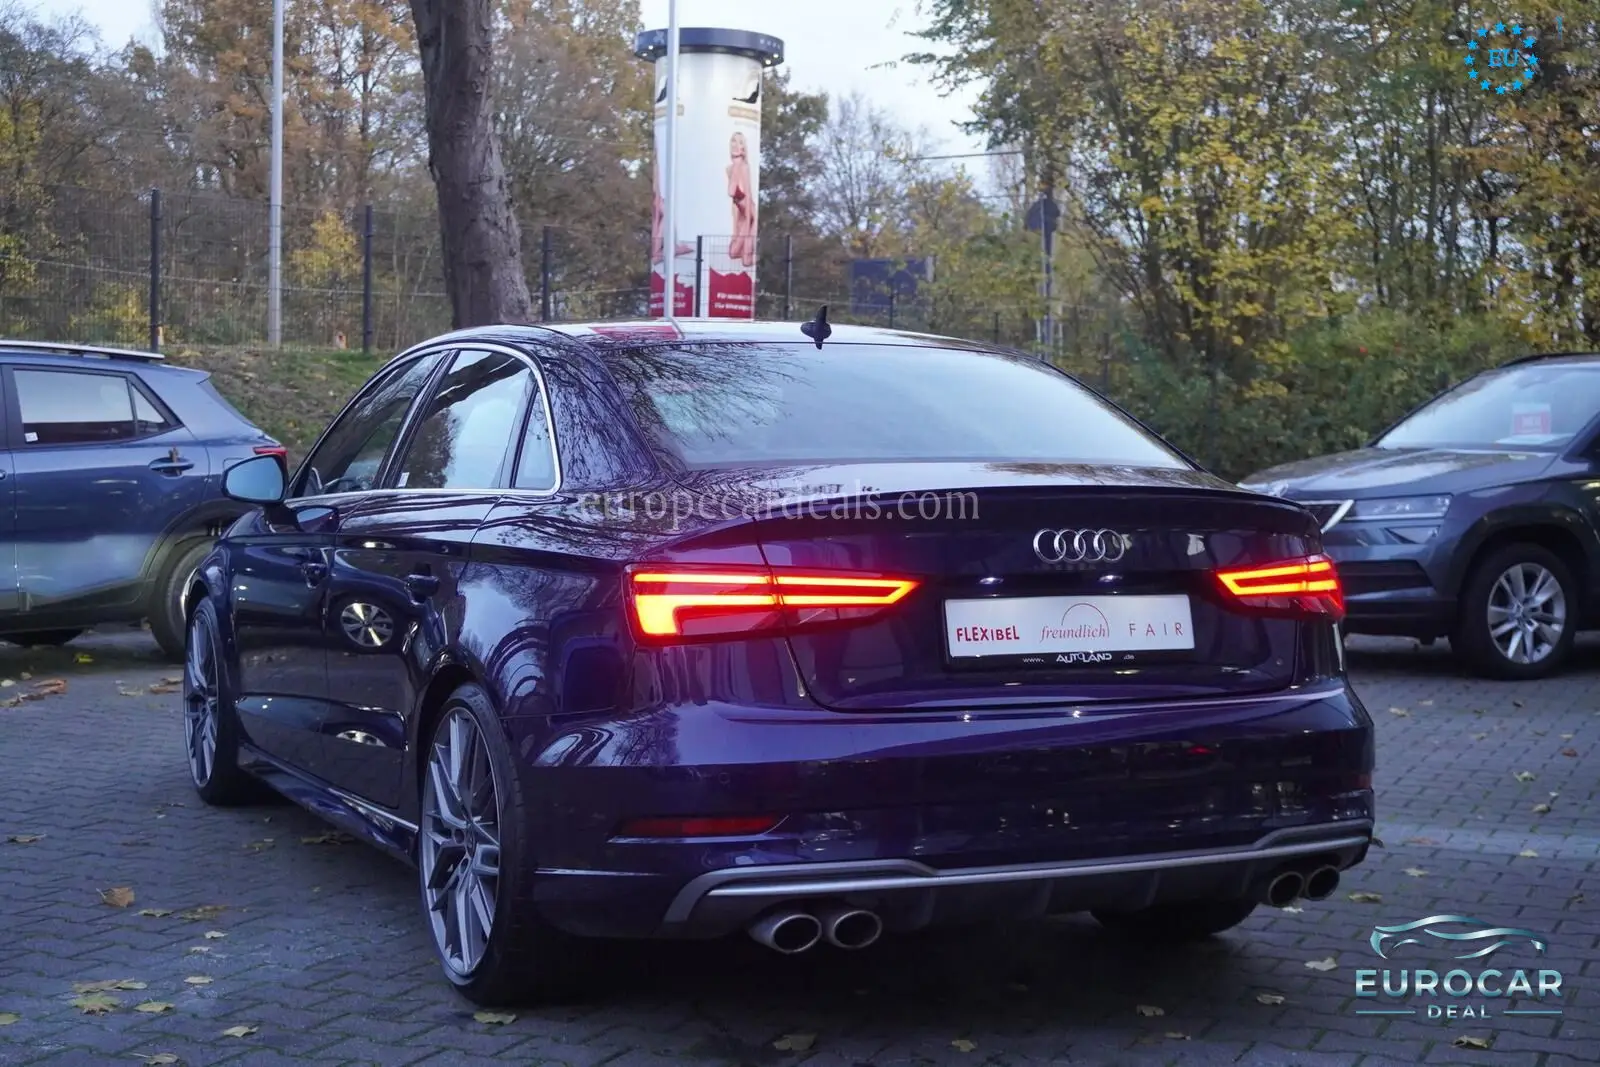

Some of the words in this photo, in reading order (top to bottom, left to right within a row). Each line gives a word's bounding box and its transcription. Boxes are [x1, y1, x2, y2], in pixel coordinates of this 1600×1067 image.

[956, 625, 1020, 642] FLEXIBEL
[1039, 623, 1107, 643] freundlich
[1128, 621, 1184, 637] FAIR
[1056, 652, 1113, 664] AUTOLAND
